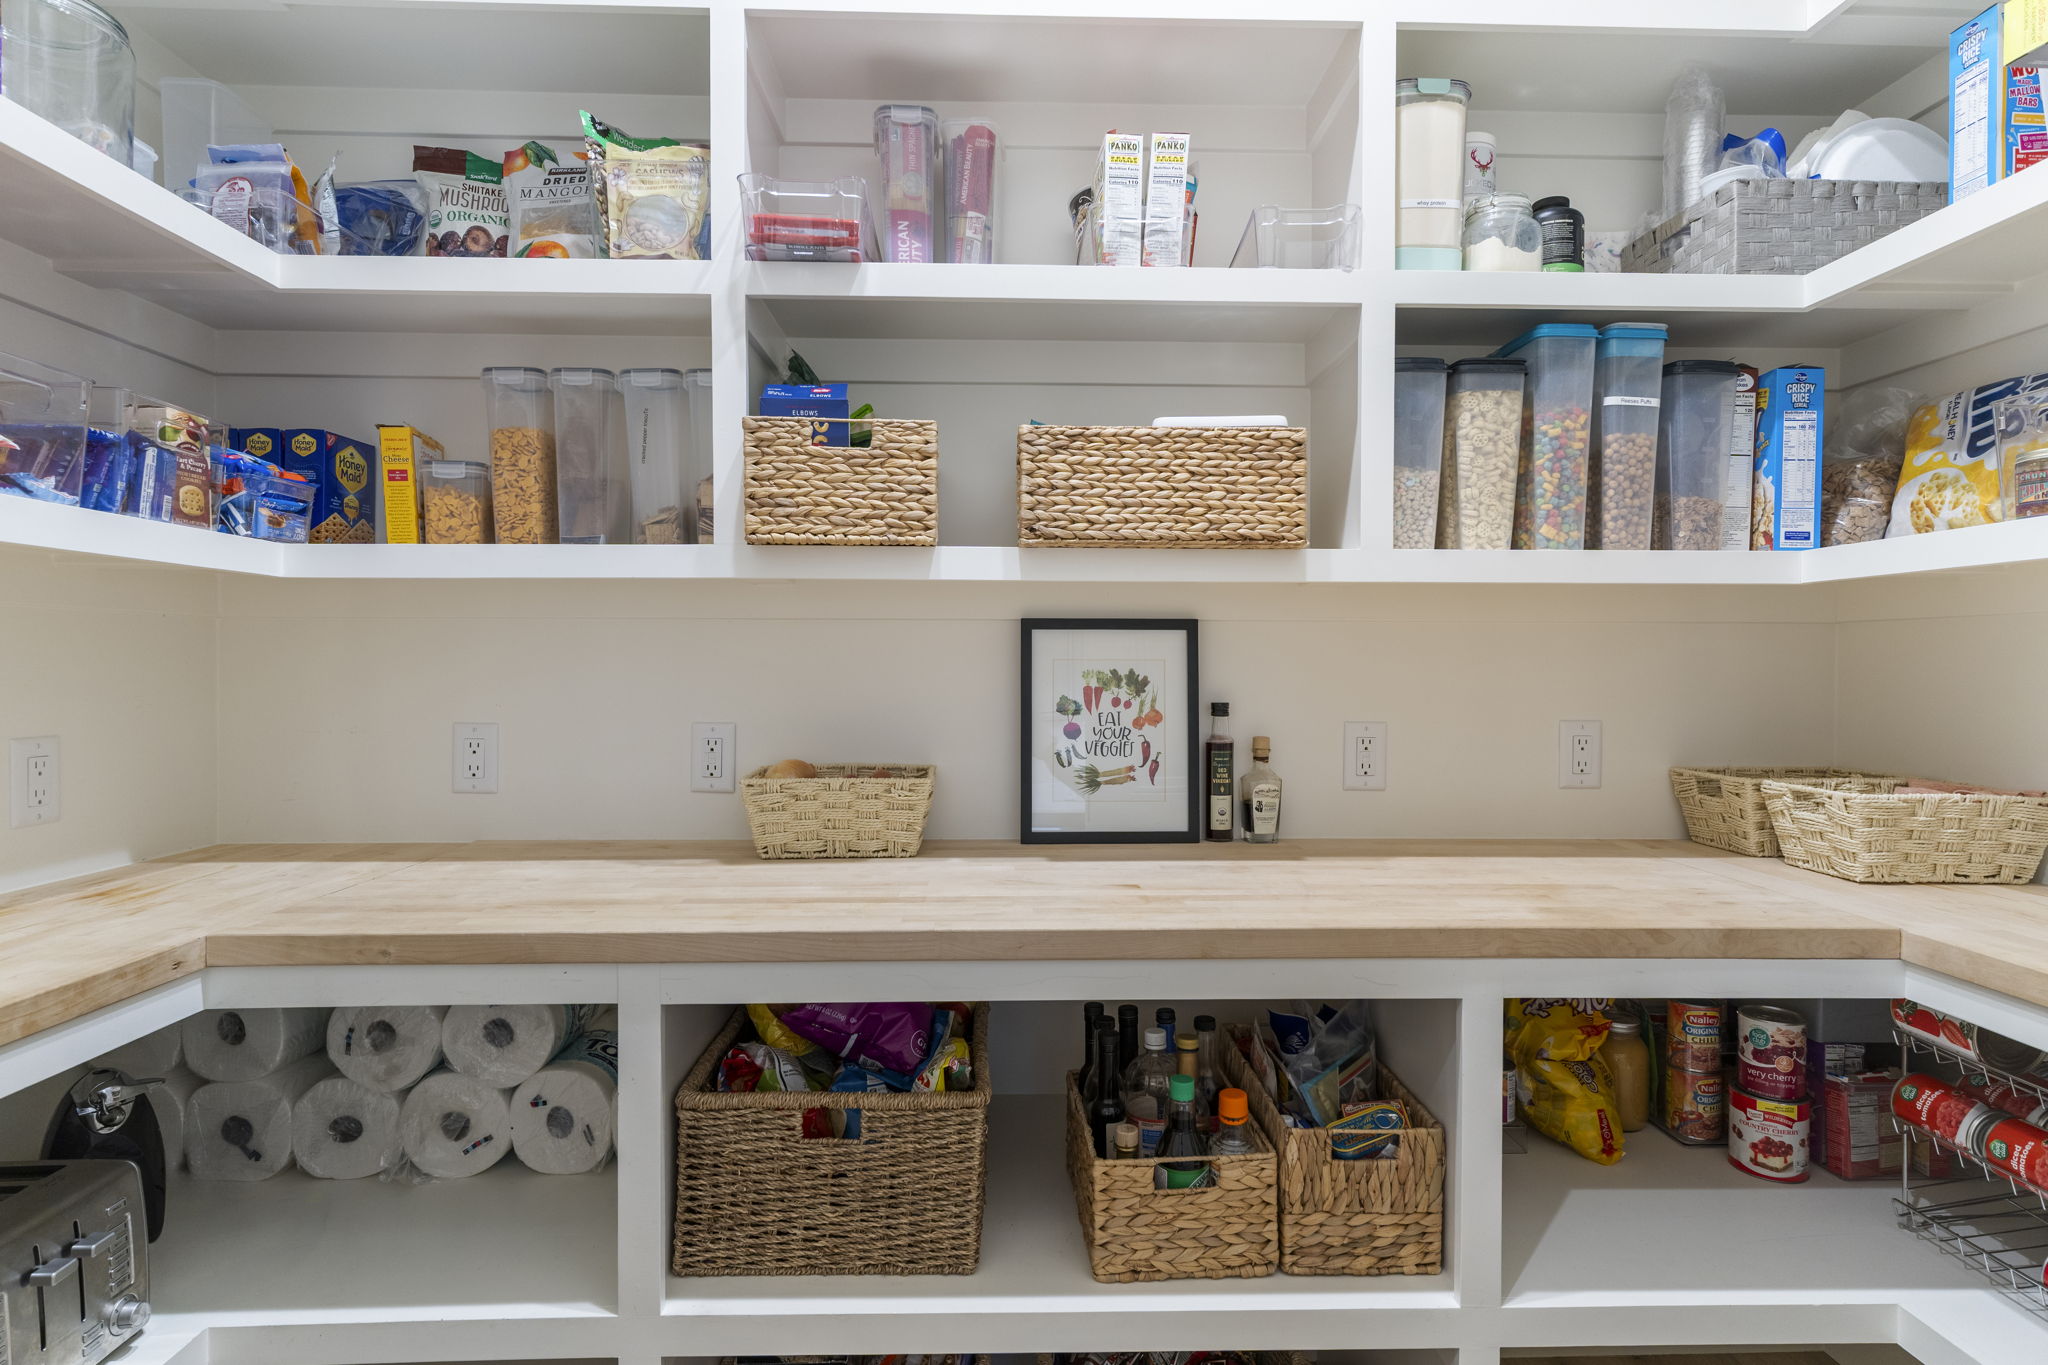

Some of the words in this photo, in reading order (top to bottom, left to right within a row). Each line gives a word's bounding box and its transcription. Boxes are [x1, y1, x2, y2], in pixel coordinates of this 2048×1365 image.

[1957, 29, 1987, 56] CRISPY
[1962, 45, 1980, 63] RICE
[2009, 85, 2041, 97] MALLOW
[2018, 97, 2037, 107] BARS
[1110, 142, 1137, 150] PANKO
[1156, 141, 1185, 150] PANKO
[543, 176, 586, 185] DRIED
[960, 167, 971, 205] AMERICAN
[966, 143, 975, 168] BEAUTY
[462, 183, 503, 197] SHIITAKE
[447, 210, 511, 227] ORGANIC
[1786, 383, 1816, 394] CRISPY
[1791, 393, 1810, 403] RICE
[249, 438, 270, 446] Honey
[293, 438, 314, 446] Honey
[188, 458, 206, 469] Cherry
[338, 455, 366, 474] Honey
[382, 455, 410, 463] Cheese
[340, 468, 361, 483] Maid
[1098, 711, 1121, 726] EAT
[1093, 726, 1131, 742] YOUR
[1085, 740, 1135, 757] VEGGIES
[1689, 1015, 1719, 1025] Nalley
[1686, 1026, 1720, 1035] ORIGINAL
[1747, 1068, 1766, 1079] very
[1767, 1073, 1797, 1083] cherry
[1915, 1089, 1931, 1111] diced
[1920, 1089, 1945, 1121] tomatoes
[1739, 1119, 1771, 1134] COUNTRY
[2010, 1144, 2022, 1170] diced
